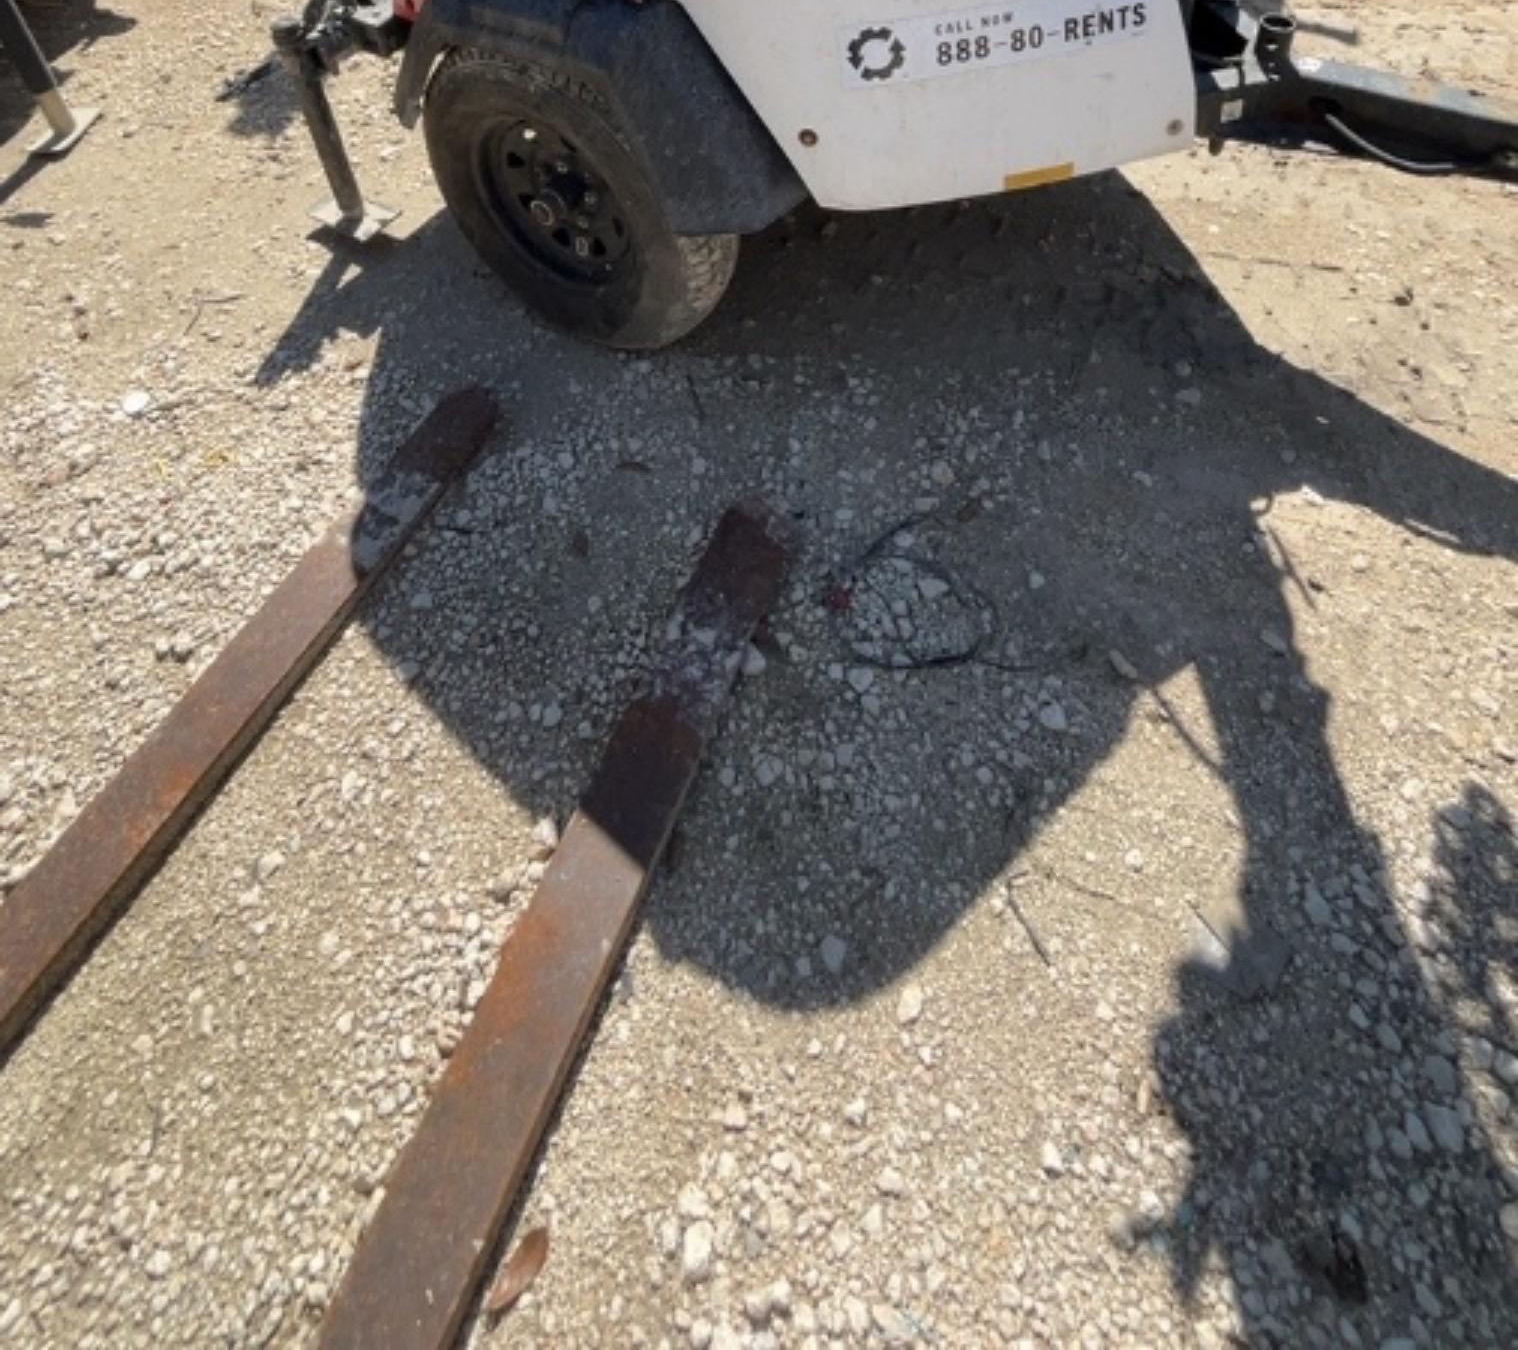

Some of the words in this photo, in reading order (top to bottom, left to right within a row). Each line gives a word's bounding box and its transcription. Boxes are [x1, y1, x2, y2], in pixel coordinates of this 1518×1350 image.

[935, 19, 974, 37] CALL
[980, 11, 1014, 28] NOW
[935, 2, 1148, 67] 888-80-RENTS
